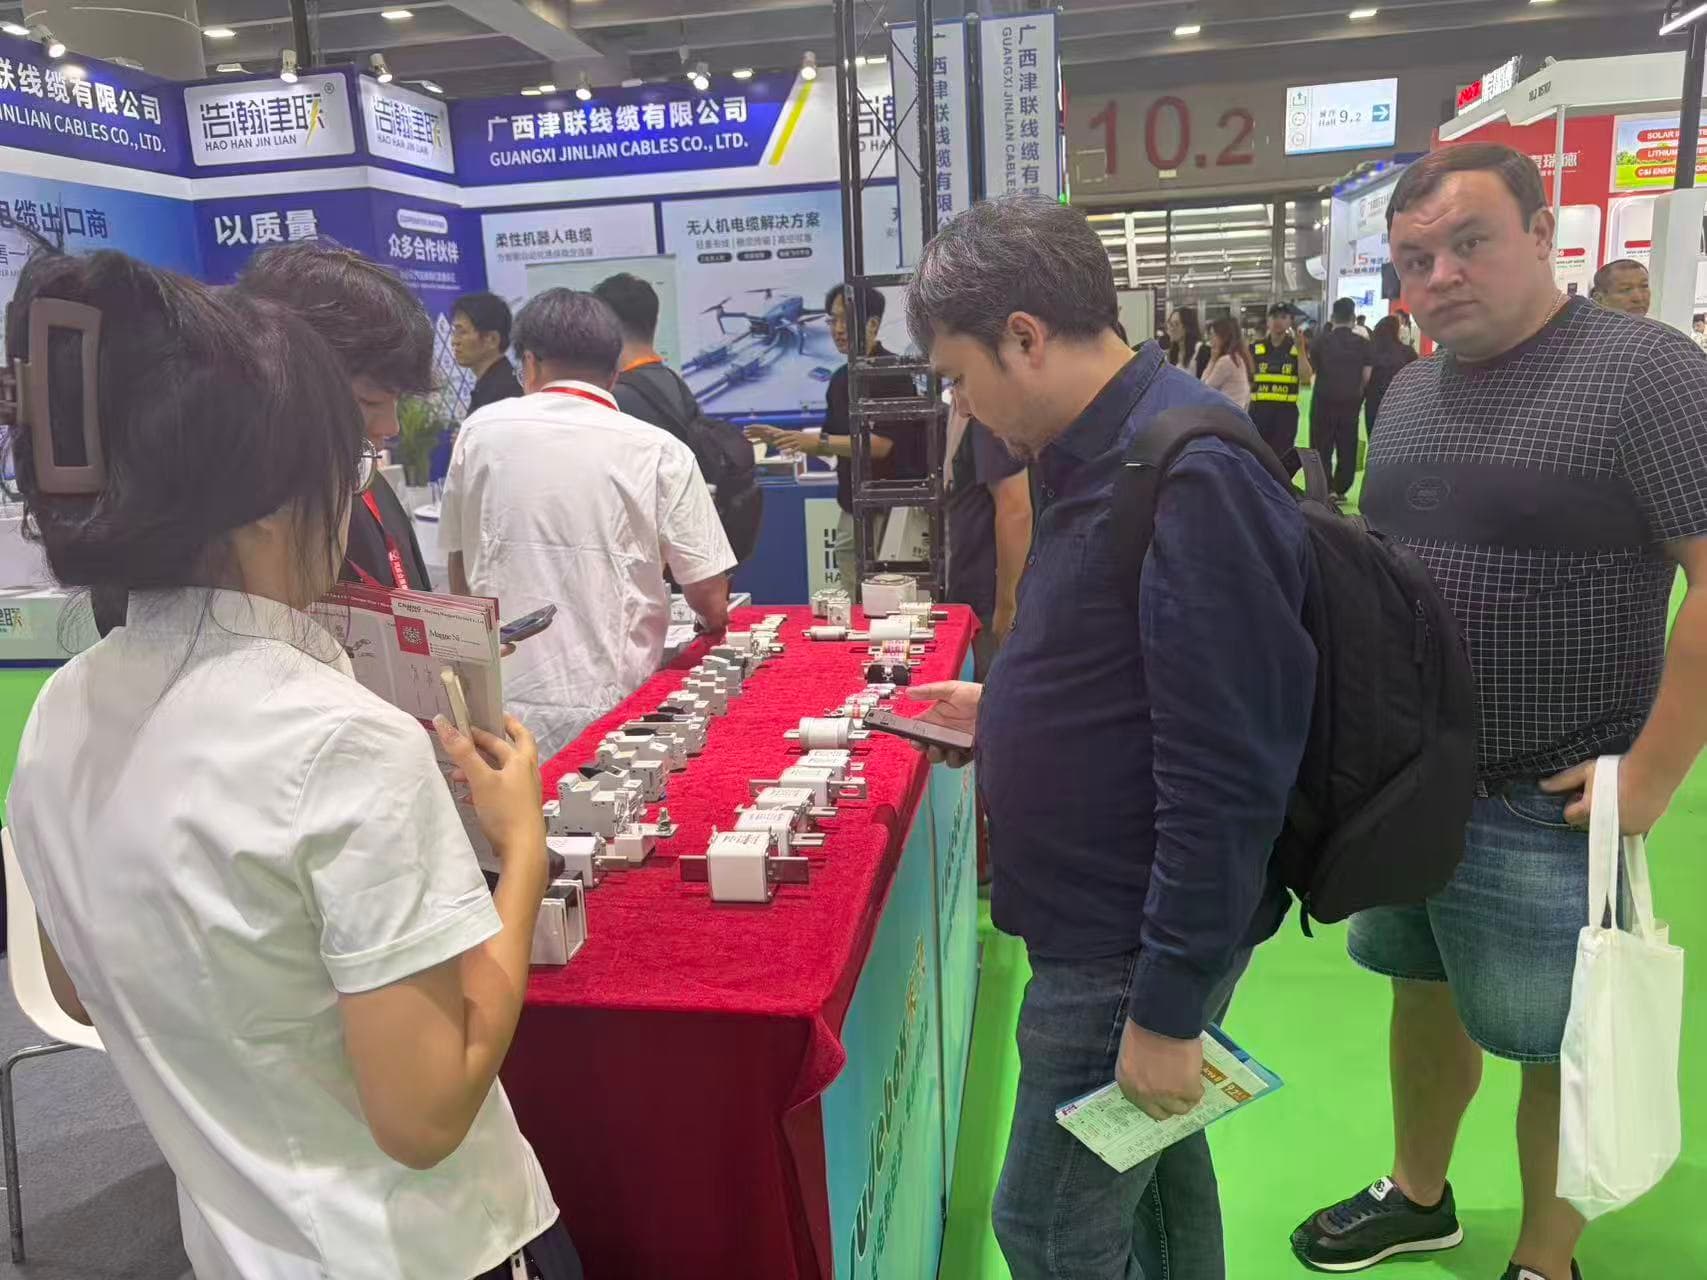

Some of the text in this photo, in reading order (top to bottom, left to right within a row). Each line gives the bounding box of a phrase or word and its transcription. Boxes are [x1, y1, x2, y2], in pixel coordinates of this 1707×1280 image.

[1002, 26, 1014, 89] GUANGXI
[54, 115, 109, 142] CABLES
[487, 96, 748, 142] 广西津联线缆有限公司
[1003, 90, 1015, 142] JINLIAN
[205, 134, 297, 152] HAO HAN JIN LIAN
[489, 146, 556, 167] GUANGXI
[559, 142, 618, 162] JINLIAN
[620, 138, 679, 157] CABLES
[715, 132, 748, 149] LTD.
[1089, 95, 1256, 175] 10.2
[1647, 132, 1674, 140] SOLAR
[214, 208, 319, 247] 以质量
[495, 226, 593, 249] 柔性机器人电缆
[687, 211, 821, 236] 无人机电缆解决方案
[388, 232, 460, 264] 众多合作伙伴
